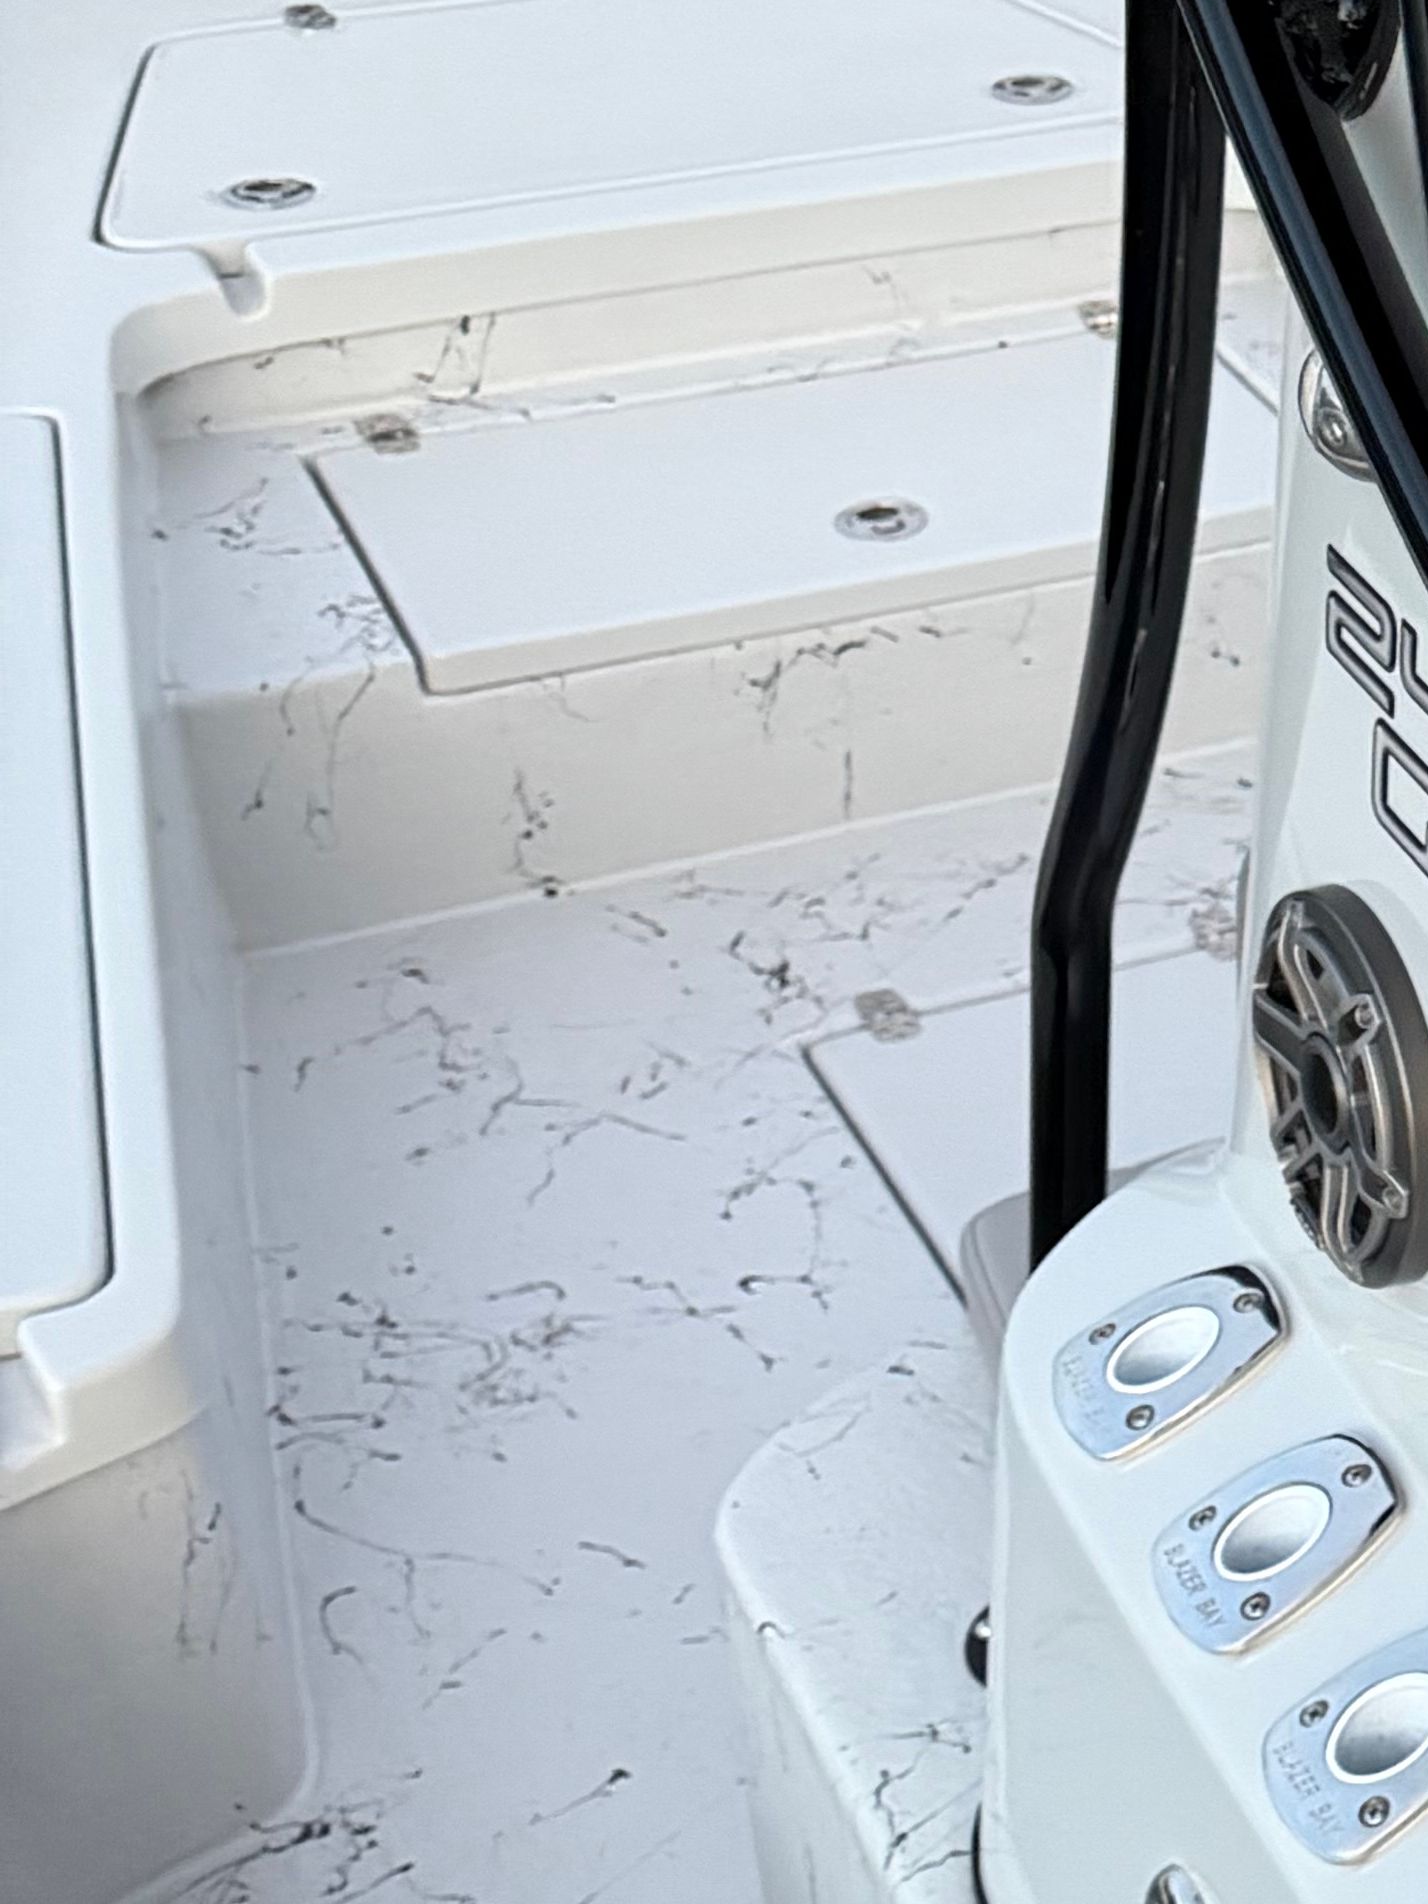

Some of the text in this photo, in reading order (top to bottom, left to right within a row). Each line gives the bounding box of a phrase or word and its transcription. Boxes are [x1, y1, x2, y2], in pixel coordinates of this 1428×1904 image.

[1163, 1543, 1226, 1628] BLAZER BAY
[1272, 1741, 1345, 1834] BLAZER BAY
